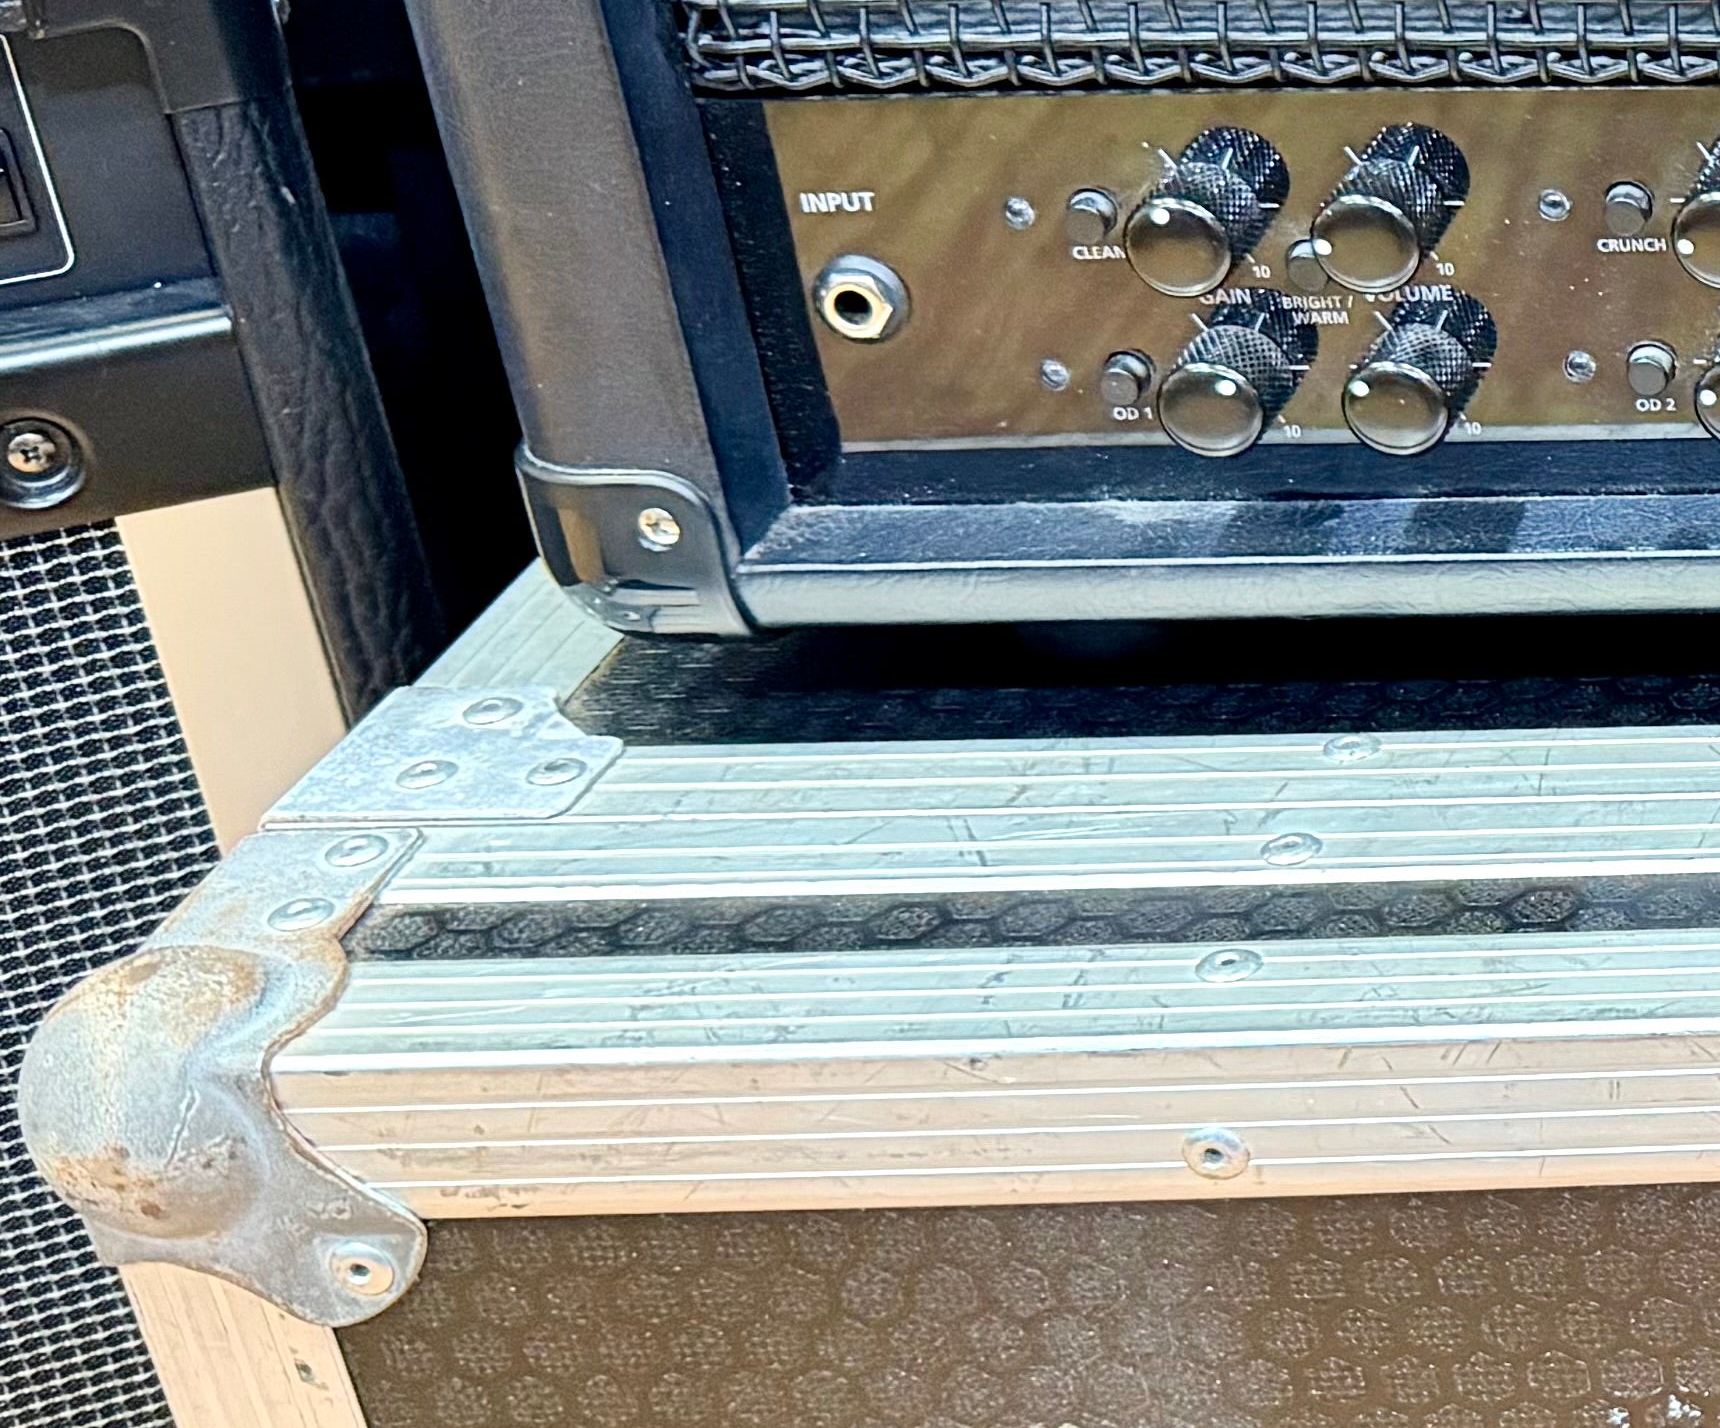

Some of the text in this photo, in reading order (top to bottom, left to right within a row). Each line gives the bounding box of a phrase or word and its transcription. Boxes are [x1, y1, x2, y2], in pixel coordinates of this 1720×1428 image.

[800, 191, 875, 213] INPUT
[1597, 238, 1667, 254] CRUNCH
[1252, 265, 1271, 279] 10
[1436, 263, 1455, 276] 10
[1282, 295, 1343, 311] BRIGHT
[1292, 311, 1350, 325] WARM
[1635, 398, 1677, 412] OD 2
[1112, 406, 1153, 421] OD 1
